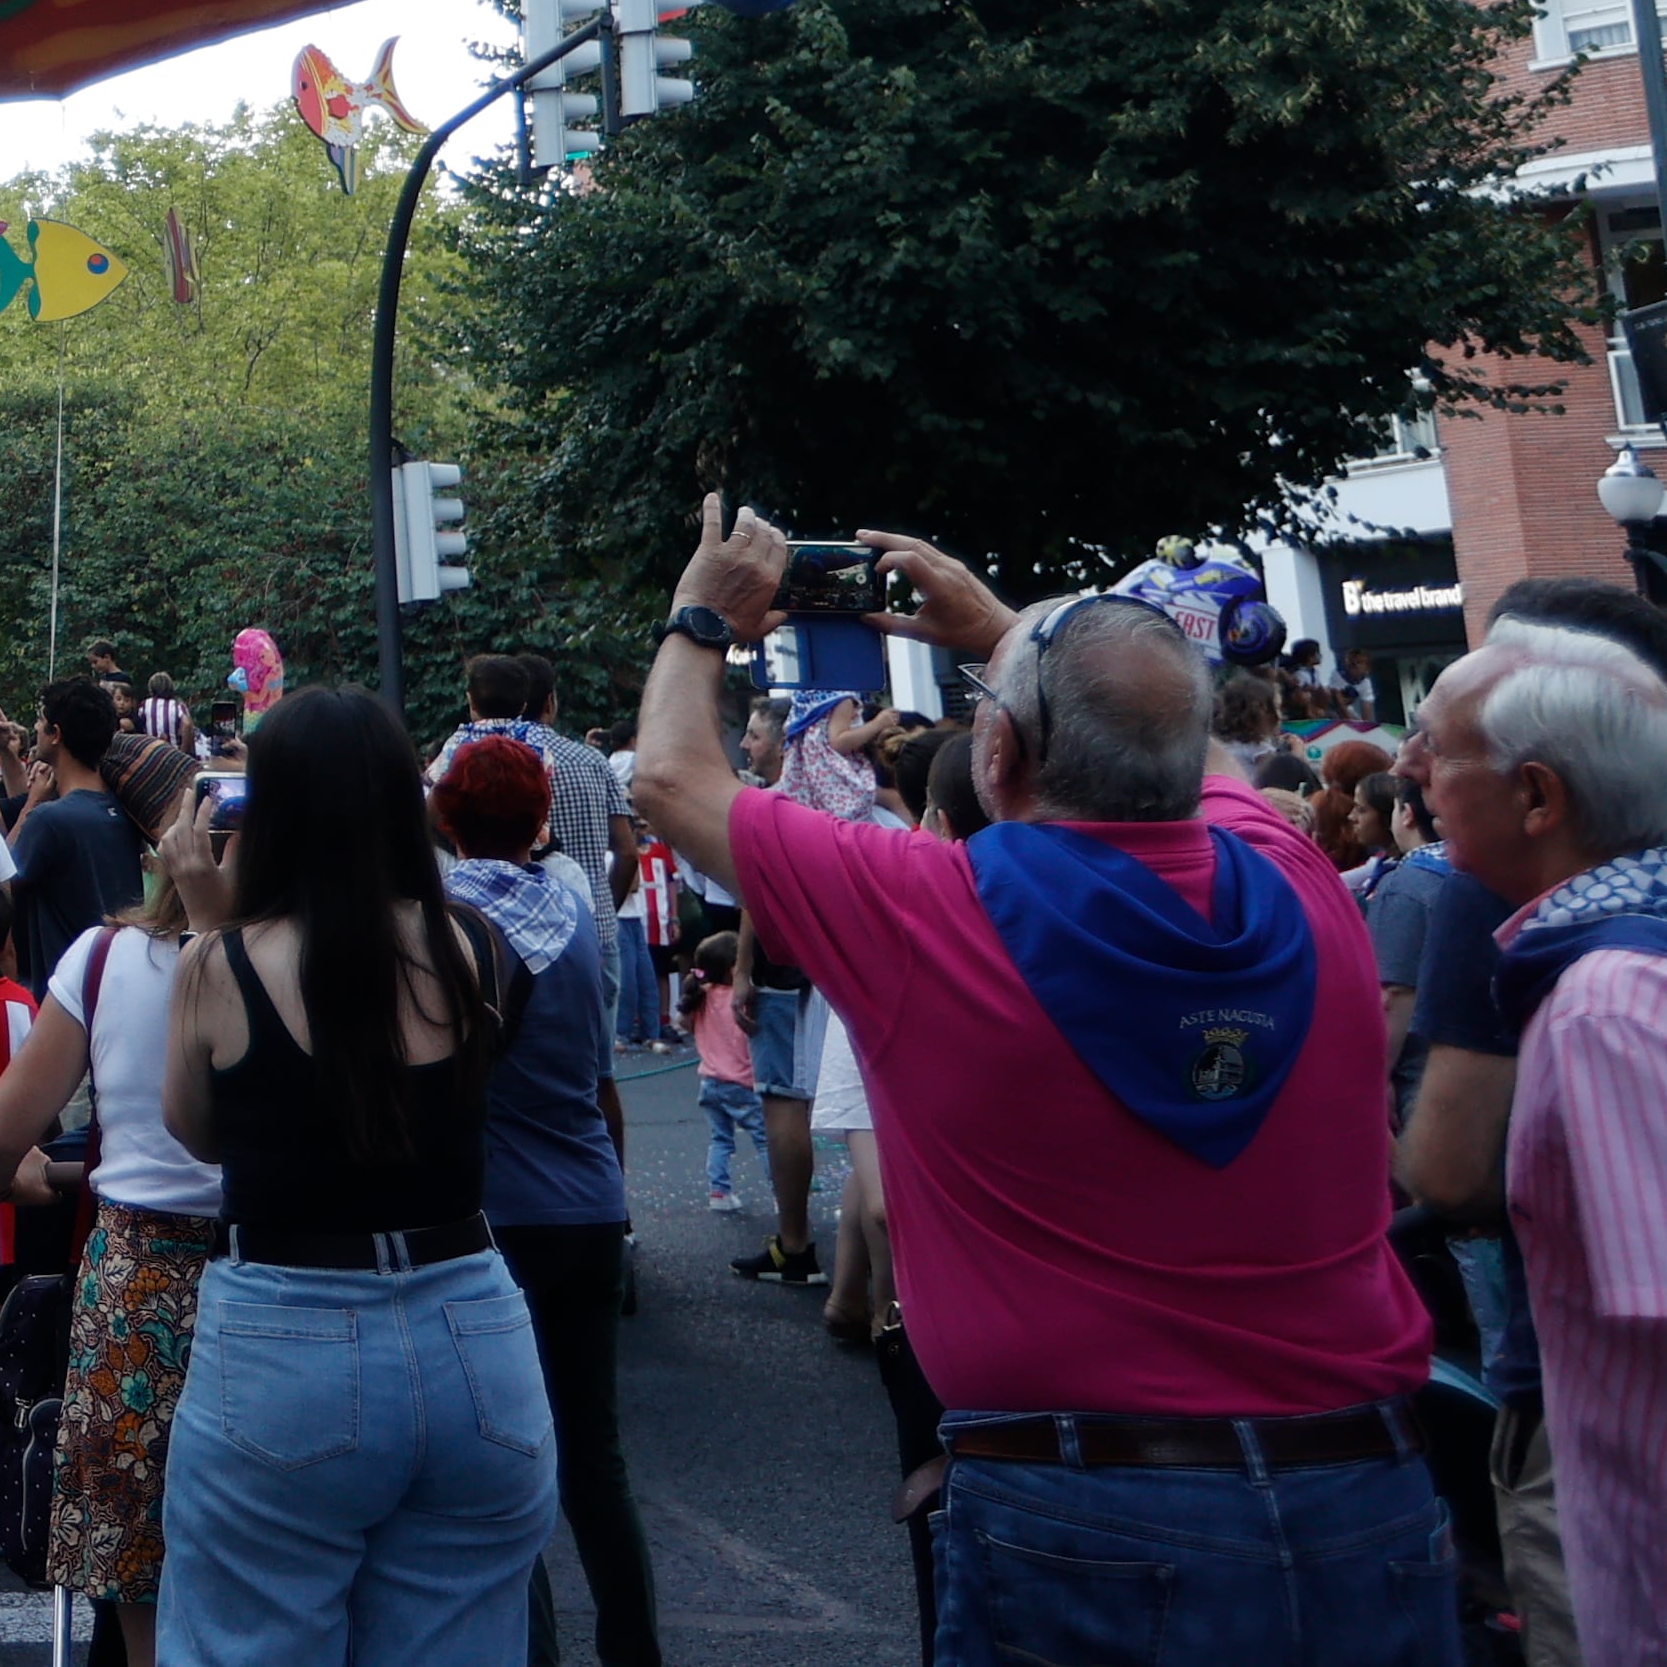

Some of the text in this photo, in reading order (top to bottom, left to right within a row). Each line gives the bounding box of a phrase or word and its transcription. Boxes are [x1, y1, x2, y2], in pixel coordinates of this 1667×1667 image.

[1361, 591, 1385, 614] the
[1383, 586, 1422, 613] travel
[1419, 582, 1463, 609] brand
[1179, 1008, 1276, 1031] ASTE NAGUSIA
